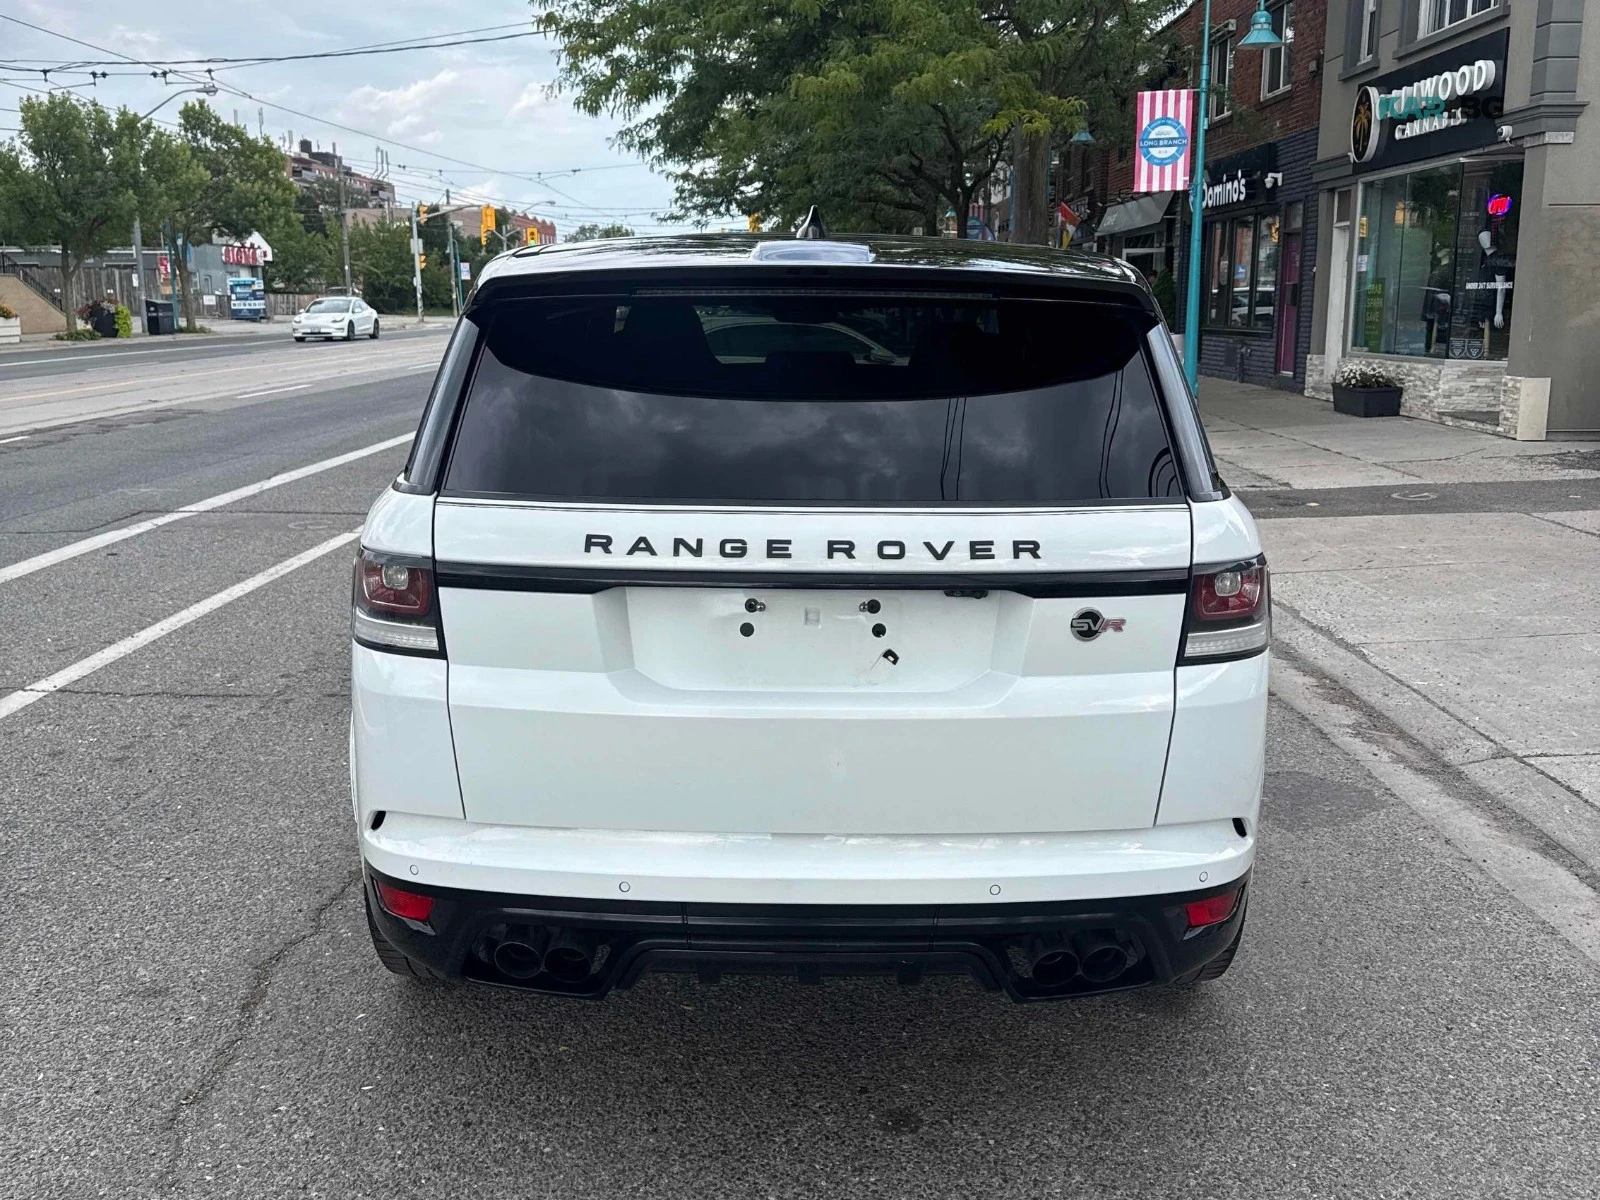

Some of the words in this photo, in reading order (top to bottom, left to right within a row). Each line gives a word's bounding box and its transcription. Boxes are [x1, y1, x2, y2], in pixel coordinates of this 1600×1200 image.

[1202, 169, 1246, 210] Domino's
[584, 533, 792, 559] RANGE
[827, 539, 1042, 561] ROVER
